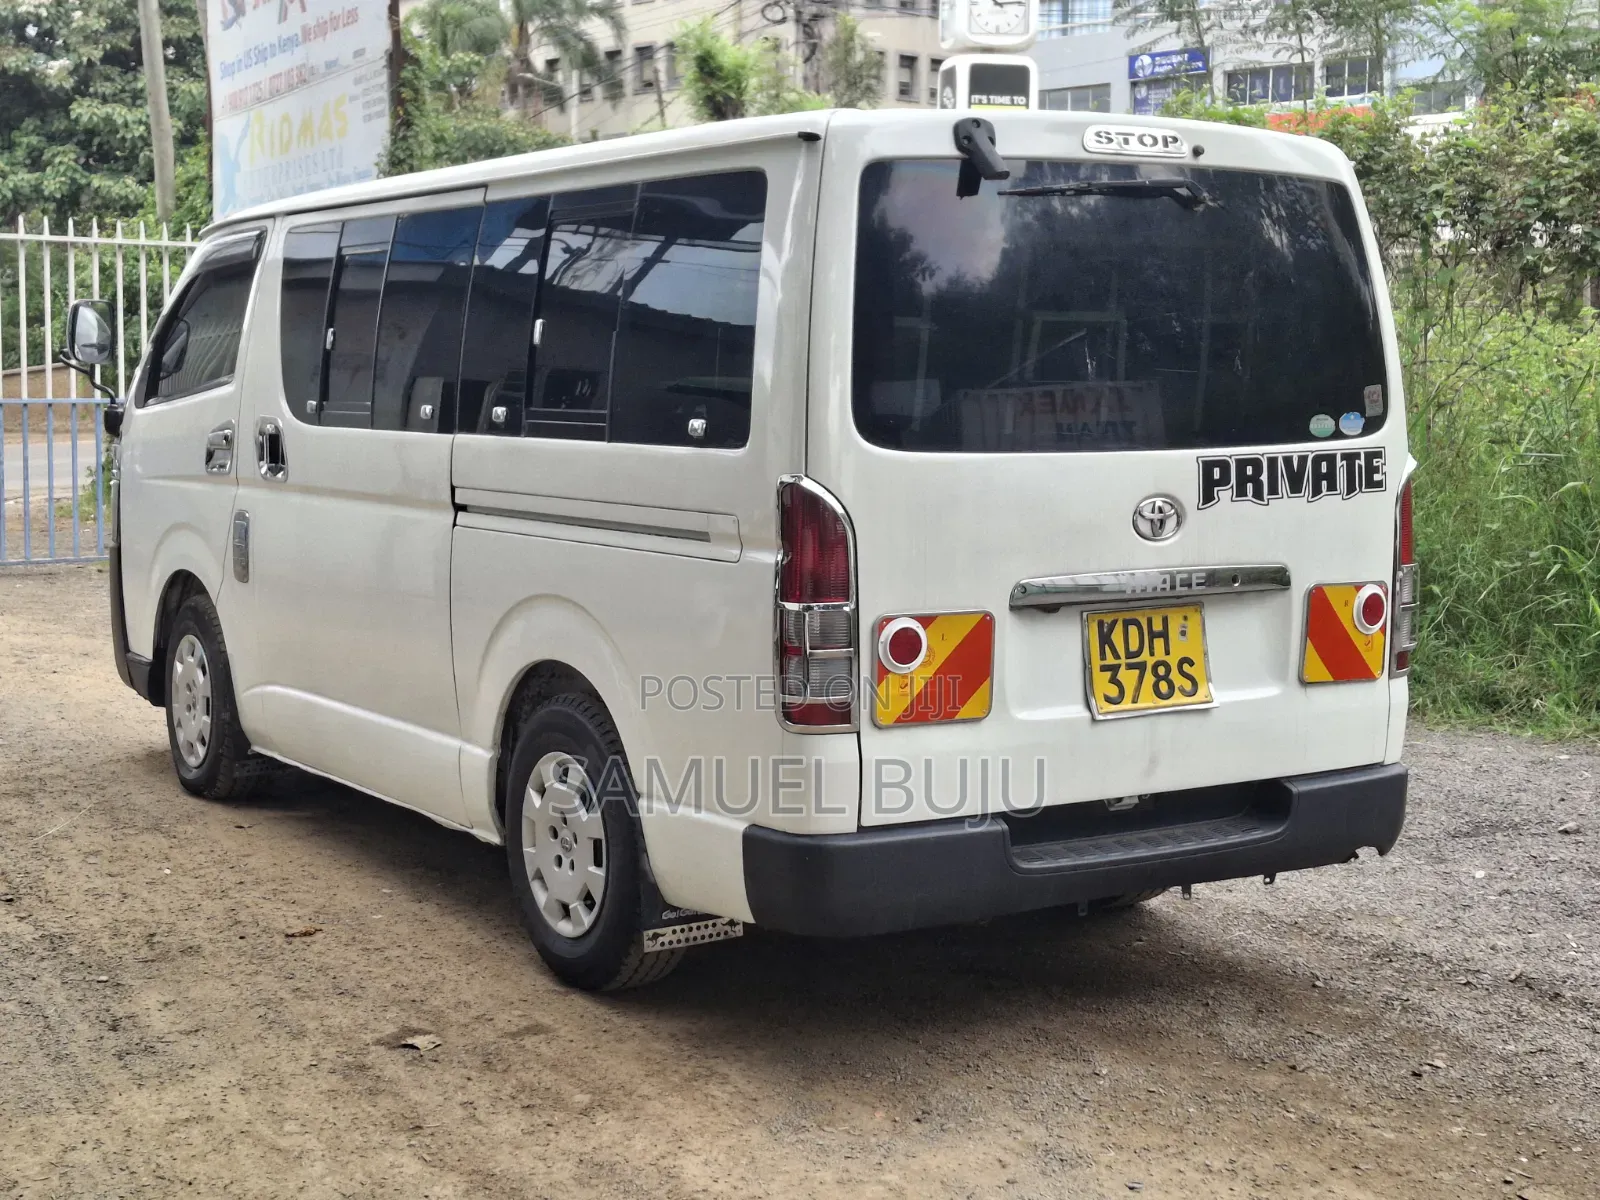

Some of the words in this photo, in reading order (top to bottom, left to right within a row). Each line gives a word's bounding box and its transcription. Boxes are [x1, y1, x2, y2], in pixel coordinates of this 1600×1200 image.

[220, 60, 236, 81] Shop
[243, 48, 253, 69] US
[253, 42, 268, 68] Ship
[269, 41, 277, 58] to
[329, 10, 341, 32] for
[342, 6, 359, 29] Less
[971, 95, 988, 104] IT'S
[989, 95, 1011, 105] TIME
[1013, 96, 1027, 105] TO
[248, 92, 349, 167] RIDMAS
[1093, 130, 1179, 149] STOP
[1197, 447, 1386, 510] PRIVATE
[1097, 615, 1171, 661] KDH
[1099, 656, 1199, 705] 378S
